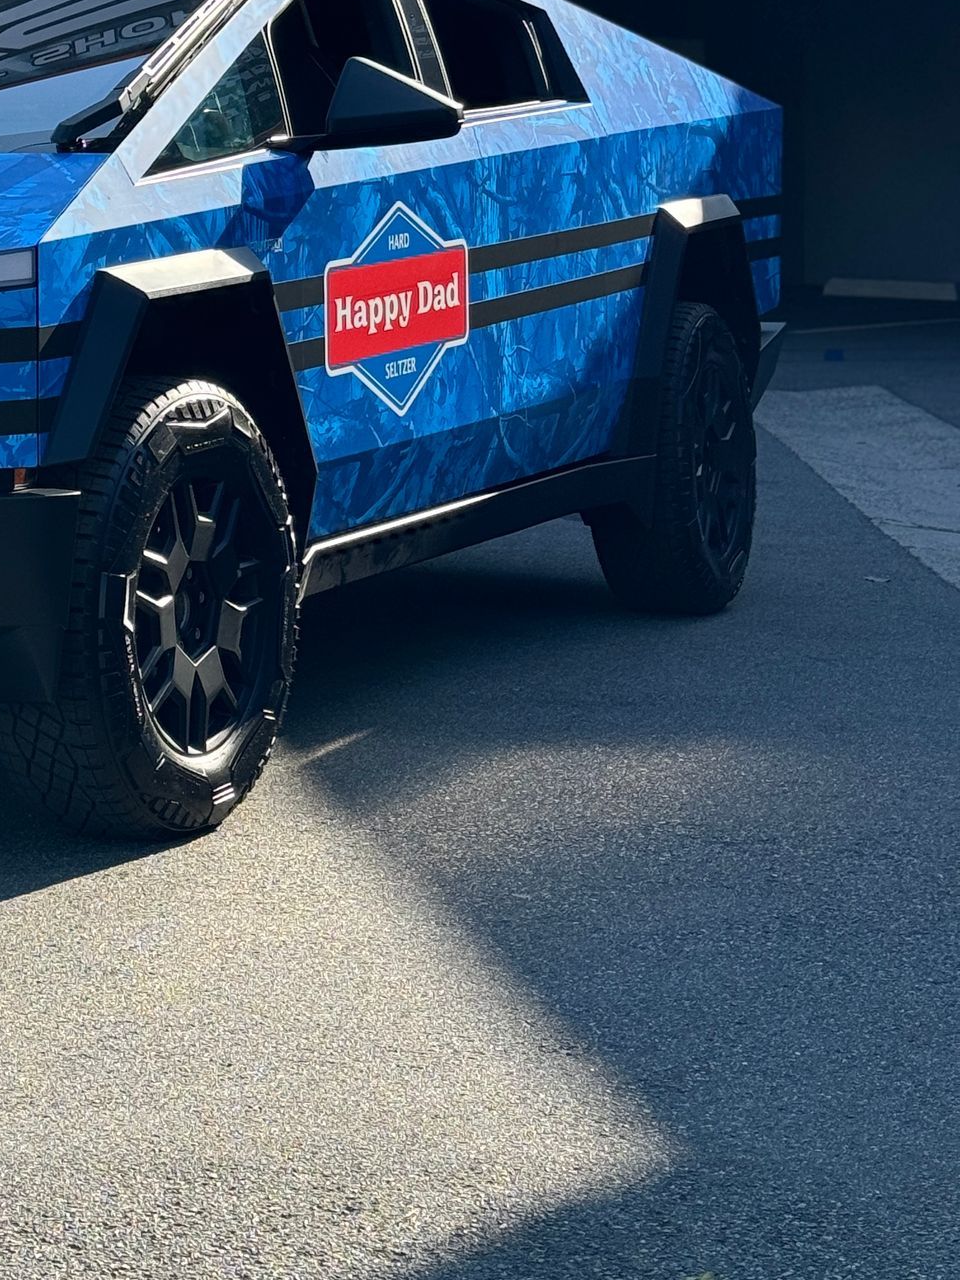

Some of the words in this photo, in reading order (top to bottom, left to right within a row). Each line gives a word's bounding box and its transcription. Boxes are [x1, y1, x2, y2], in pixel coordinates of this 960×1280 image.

[388, 232, 410, 251] HARD
[334, 289, 414, 335] Happy
[416, 271, 461, 315] Dad
[384, 357, 417, 380] SELTZER
